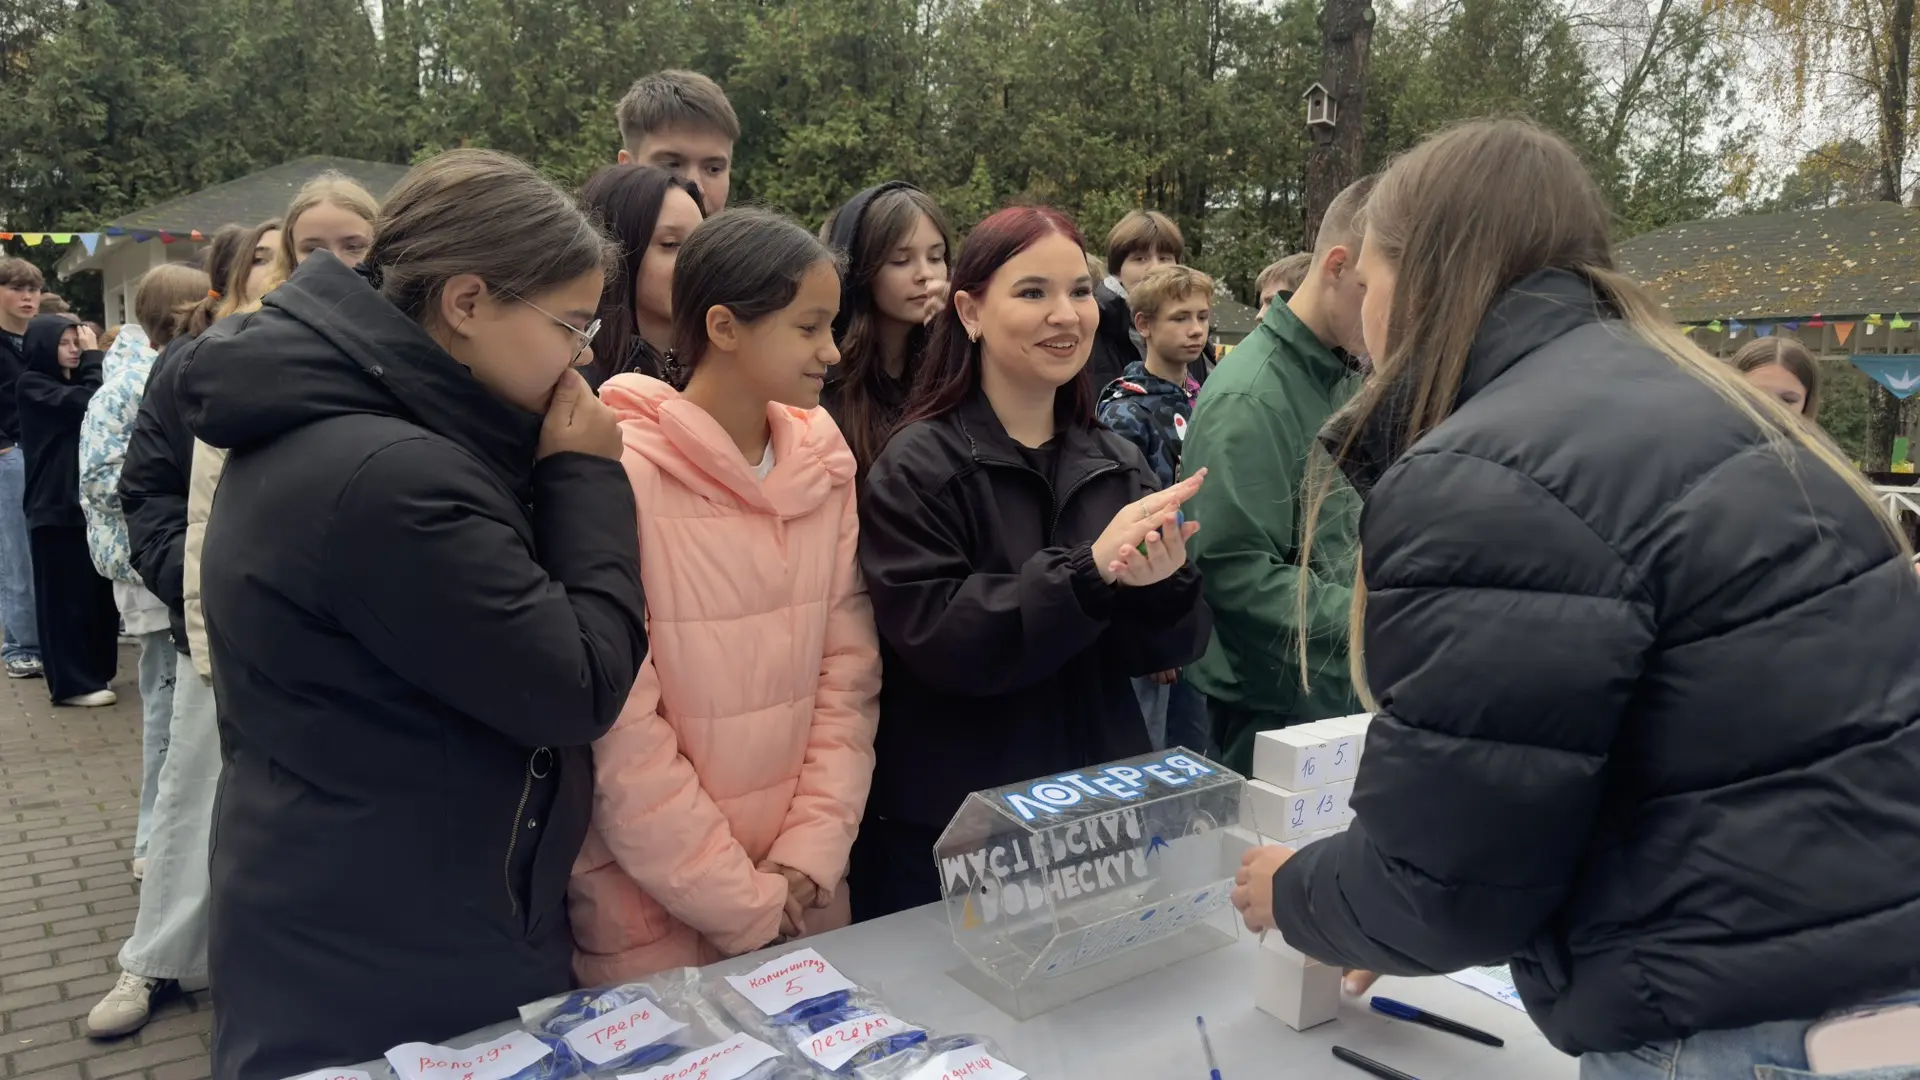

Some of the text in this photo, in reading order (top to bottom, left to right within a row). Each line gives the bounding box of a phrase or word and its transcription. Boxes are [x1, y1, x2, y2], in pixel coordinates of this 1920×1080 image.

[1301, 757, 1316, 778] 16
[1006, 754, 1212, 820] ЛОТЕРЕЯ
[1316, 795, 1333, 815] 13
[785, 975, 803, 996] 5
[613, 1039, 627, 1051] 8
[420, 1043, 512, 1072] Вологда
[653, 1042, 744, 1080] моленск
